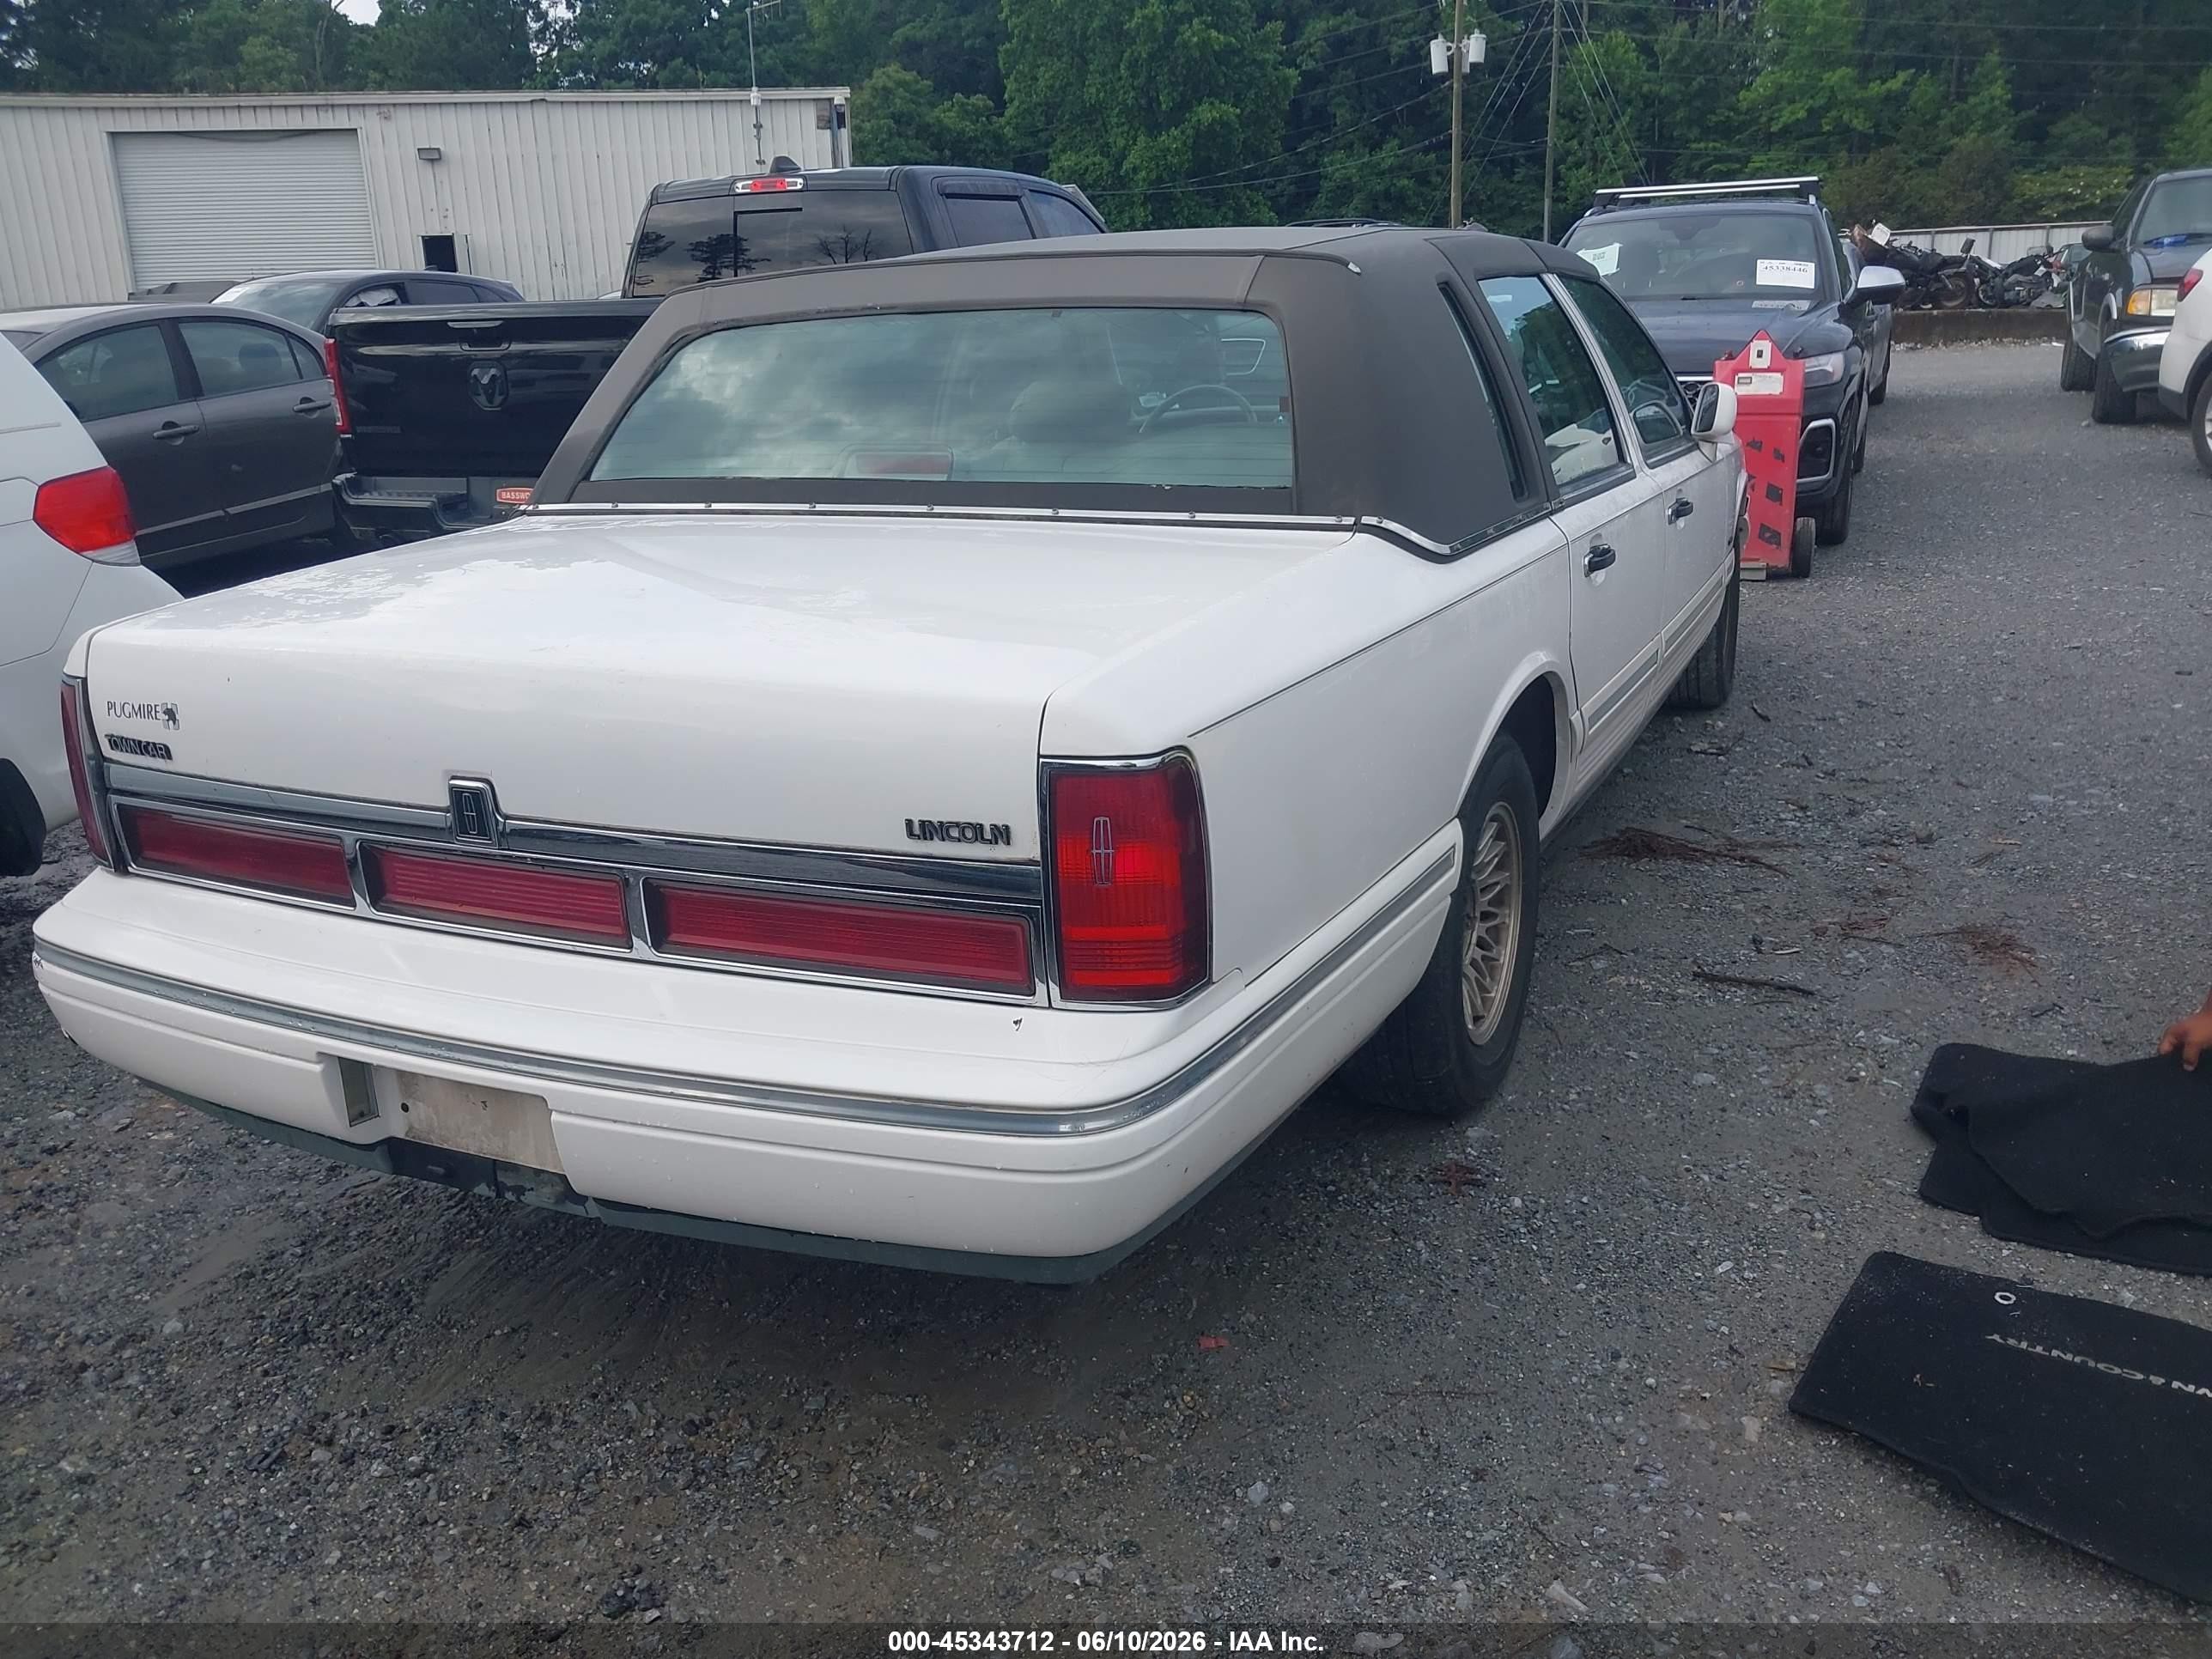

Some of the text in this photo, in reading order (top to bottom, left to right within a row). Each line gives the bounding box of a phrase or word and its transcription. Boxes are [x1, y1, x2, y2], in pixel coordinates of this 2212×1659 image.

[107, 702, 161, 720] PUGMIRE
[140, 740, 173, 761] CAR
[904, 818, 1012, 846] LINCOLN
[1984, 1334, 2144, 1380] COUNTRY
